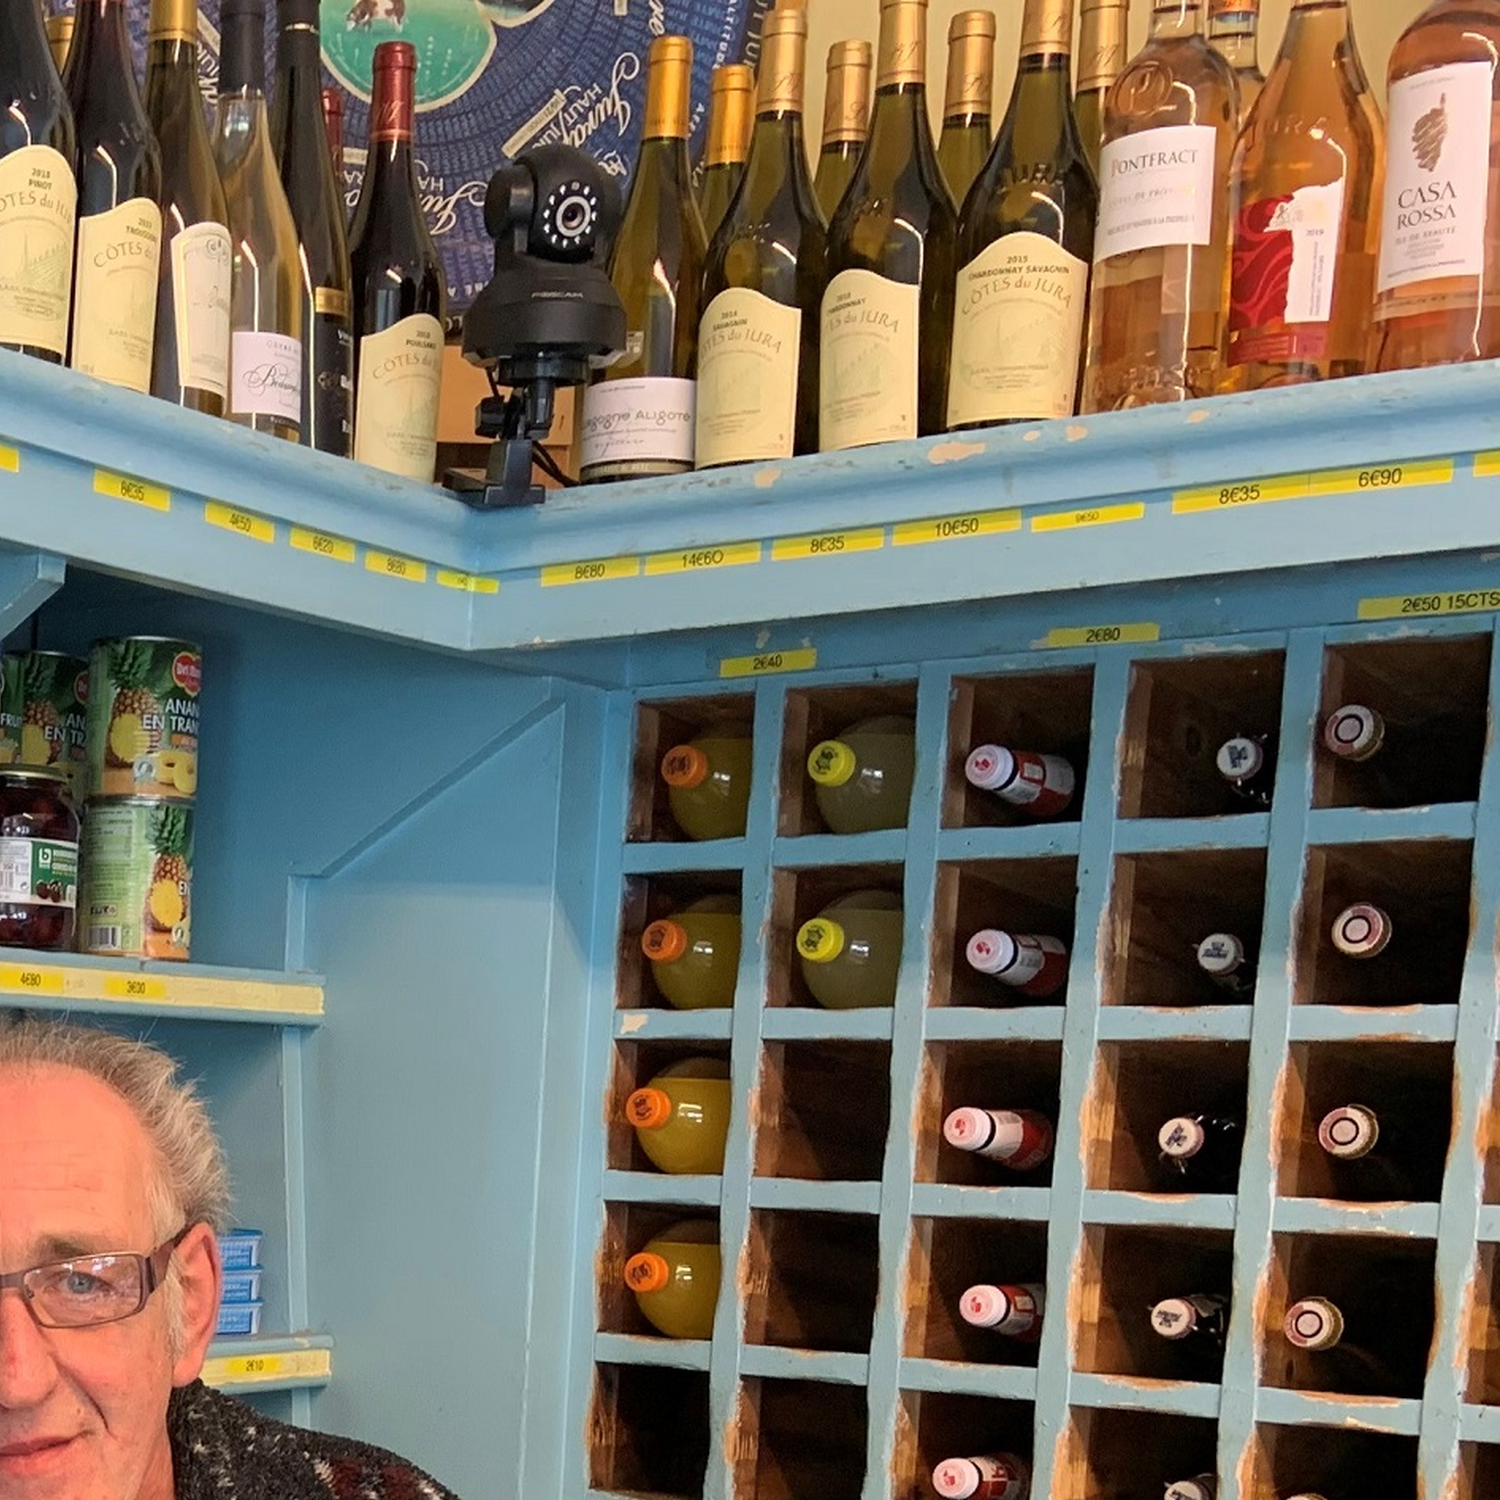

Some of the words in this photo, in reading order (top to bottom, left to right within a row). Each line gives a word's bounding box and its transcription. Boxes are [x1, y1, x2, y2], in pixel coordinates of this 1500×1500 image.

[1398, 181, 1457, 209] CASA
[1397, 204, 1456, 230] ROSSA
[1358, 468, 1402, 488] 6€90
[1219, 484, 1260, 505] 8€35
[934, 518, 979, 536] 10€50
[810, 536, 845, 553] 8€35
[681, 550, 724, 567] 14€60
[1402, 597, 1441, 613] 2€50
[1447, 592, 1500, 611] 15CTS
[1086, 627, 1120, 643] 2€80
[753, 654, 782, 670] 2€40
[143, 714, 164, 730] EN
